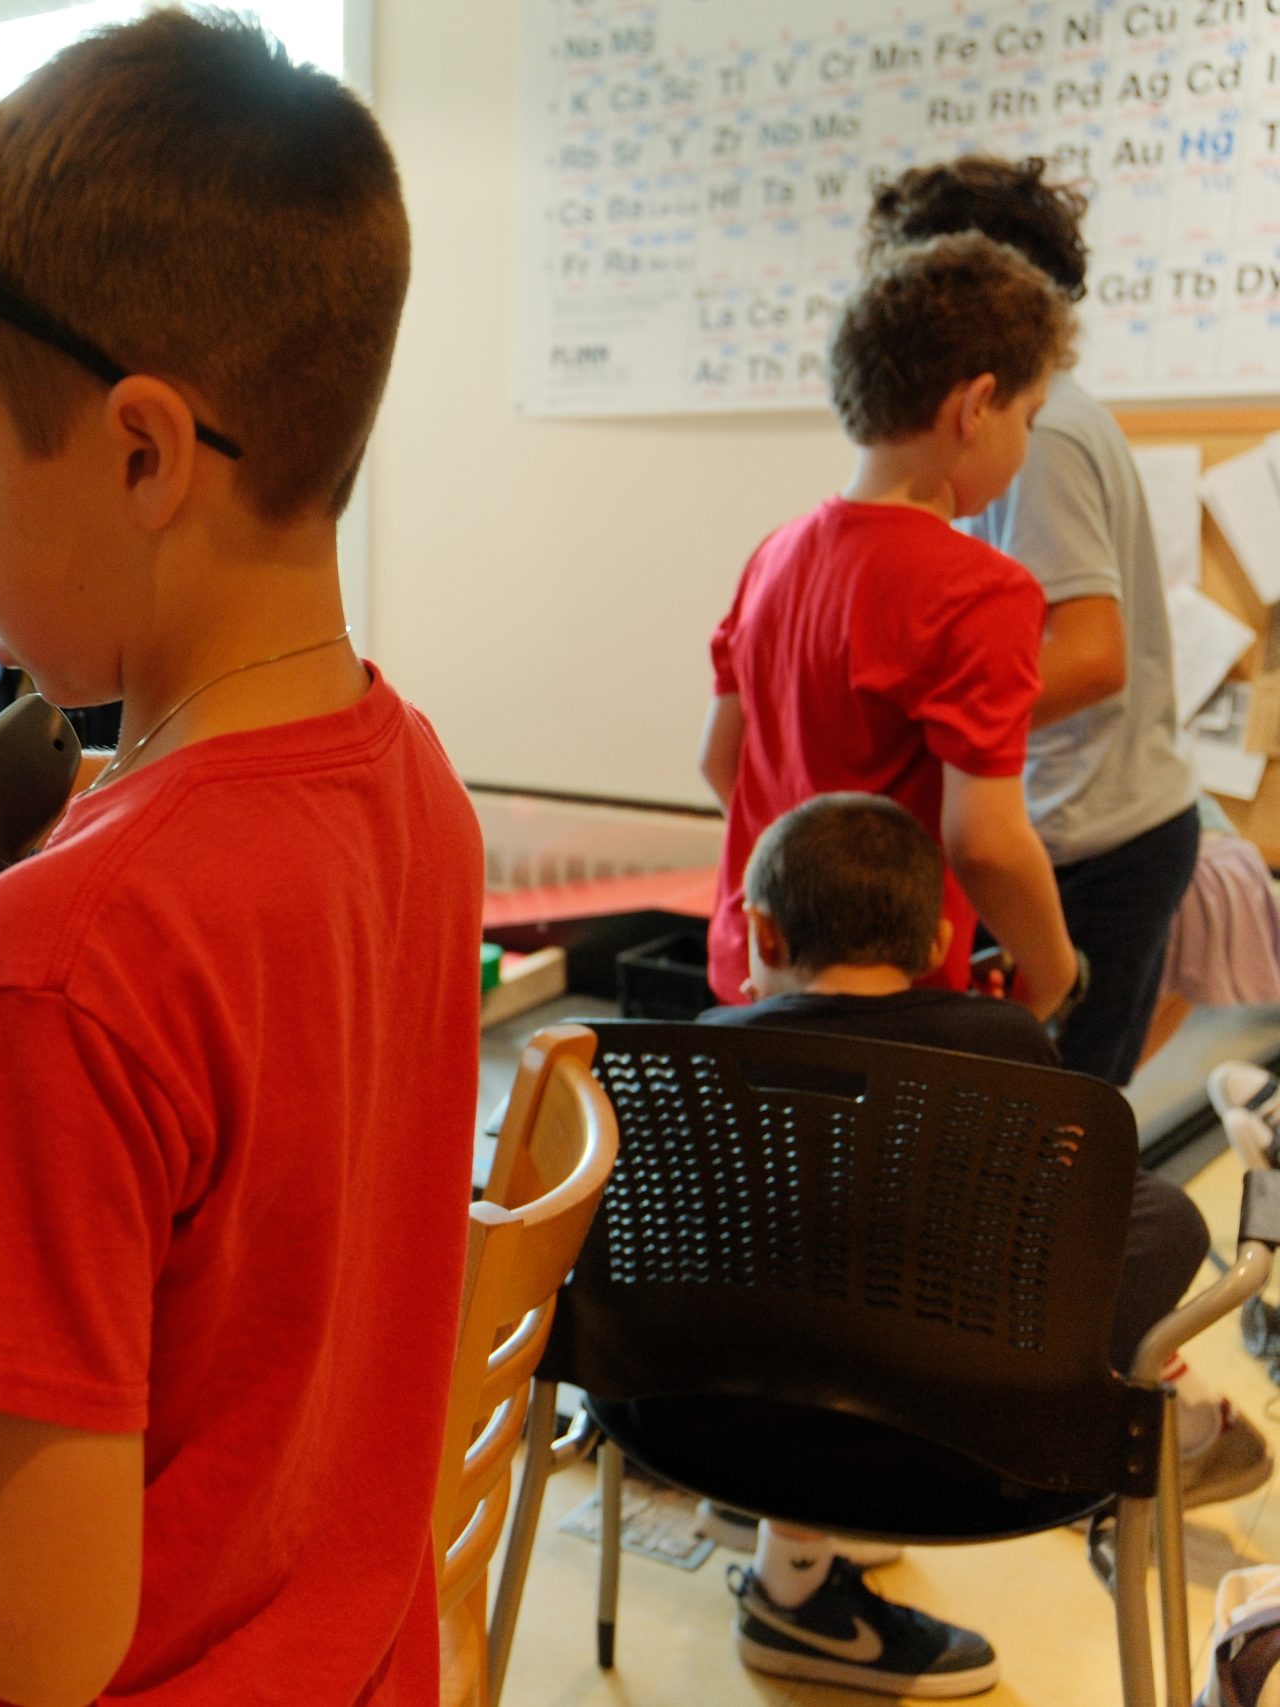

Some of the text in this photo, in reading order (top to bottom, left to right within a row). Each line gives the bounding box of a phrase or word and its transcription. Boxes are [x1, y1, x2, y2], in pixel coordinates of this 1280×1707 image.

[872, 42, 921, 70] Mn
[934, 32, 977, 64] Fe
[992, 24, 1044, 56] Co
[1064, 10, 1102, 45] Ni
[1123, 4, 1177, 37] Cu
[927, 98, 976, 127] Ru
[989, 87, 1038, 119] Rh
[1053, 78, 1102, 112] Pd
[1119, 72, 1170, 108] Ag
[1186, 57, 1242, 95] Cd
[1111, 137, 1163, 168] Au
[1178, 127, 1234, 165] Hg
[1098, 274, 1152, 304] Gd
[1170, 267, 1217, 300] Tb
